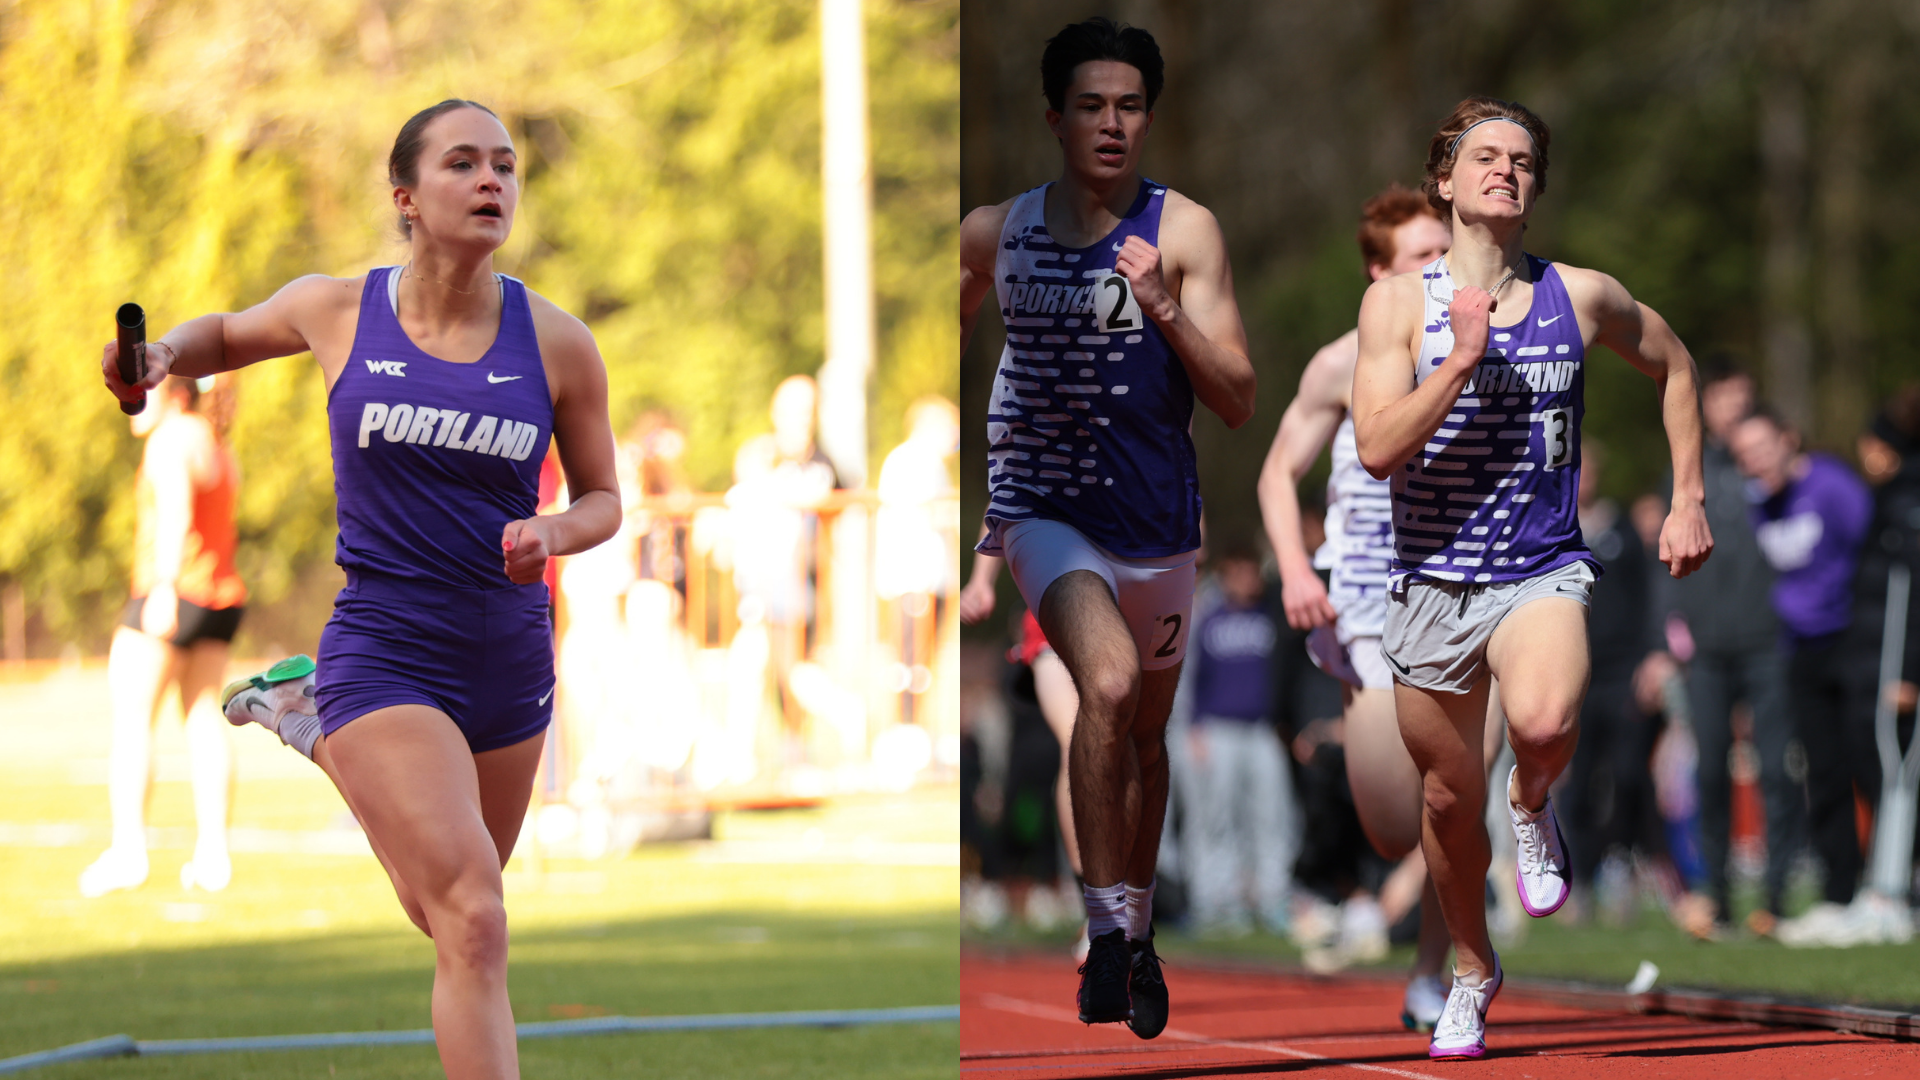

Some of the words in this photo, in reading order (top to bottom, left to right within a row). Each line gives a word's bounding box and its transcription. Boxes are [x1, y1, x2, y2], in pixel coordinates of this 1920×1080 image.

[1009, 282, 1097, 319] PORTLA
[1104, 276, 1133, 330] 2
[365, 359, 408, 377] WCC
[1460, 360, 1577, 396] ORTLAND
[358, 402, 539, 462] PORTLAND
[1552, 411, 1568, 465] 3
[1154, 613, 1182, 658] 2
